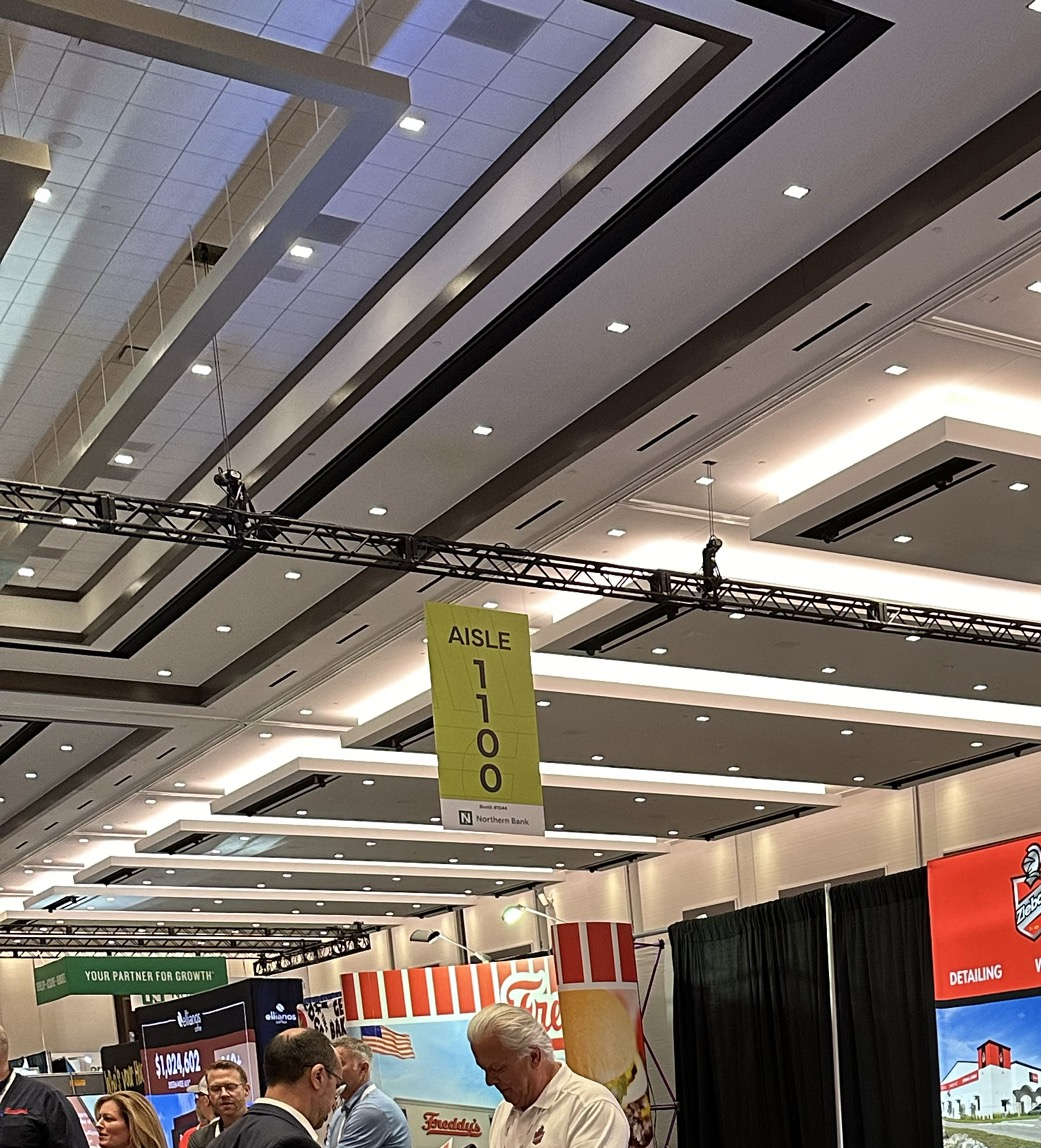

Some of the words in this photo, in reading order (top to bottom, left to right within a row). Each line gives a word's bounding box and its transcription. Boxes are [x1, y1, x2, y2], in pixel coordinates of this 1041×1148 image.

[448, 625, 511, 651] AISLE
[473, 659, 502, 793] 1100
[476, 815, 509, 825] Northern
[511, 817, 530, 826] Bank
[84, 970, 110, 982] YOUR
[112, 970, 153, 982] PARTNER
[155, 971, 173, 982] FOR
[174, 970, 213, 982] GROWTH
[949, 964, 1003, 986] DETAILING
[265, 1011, 297, 1021] ellianos
[155, 1049, 201, 1079] $1,024,602
[422, 1112, 482, 1138] Freddy's
